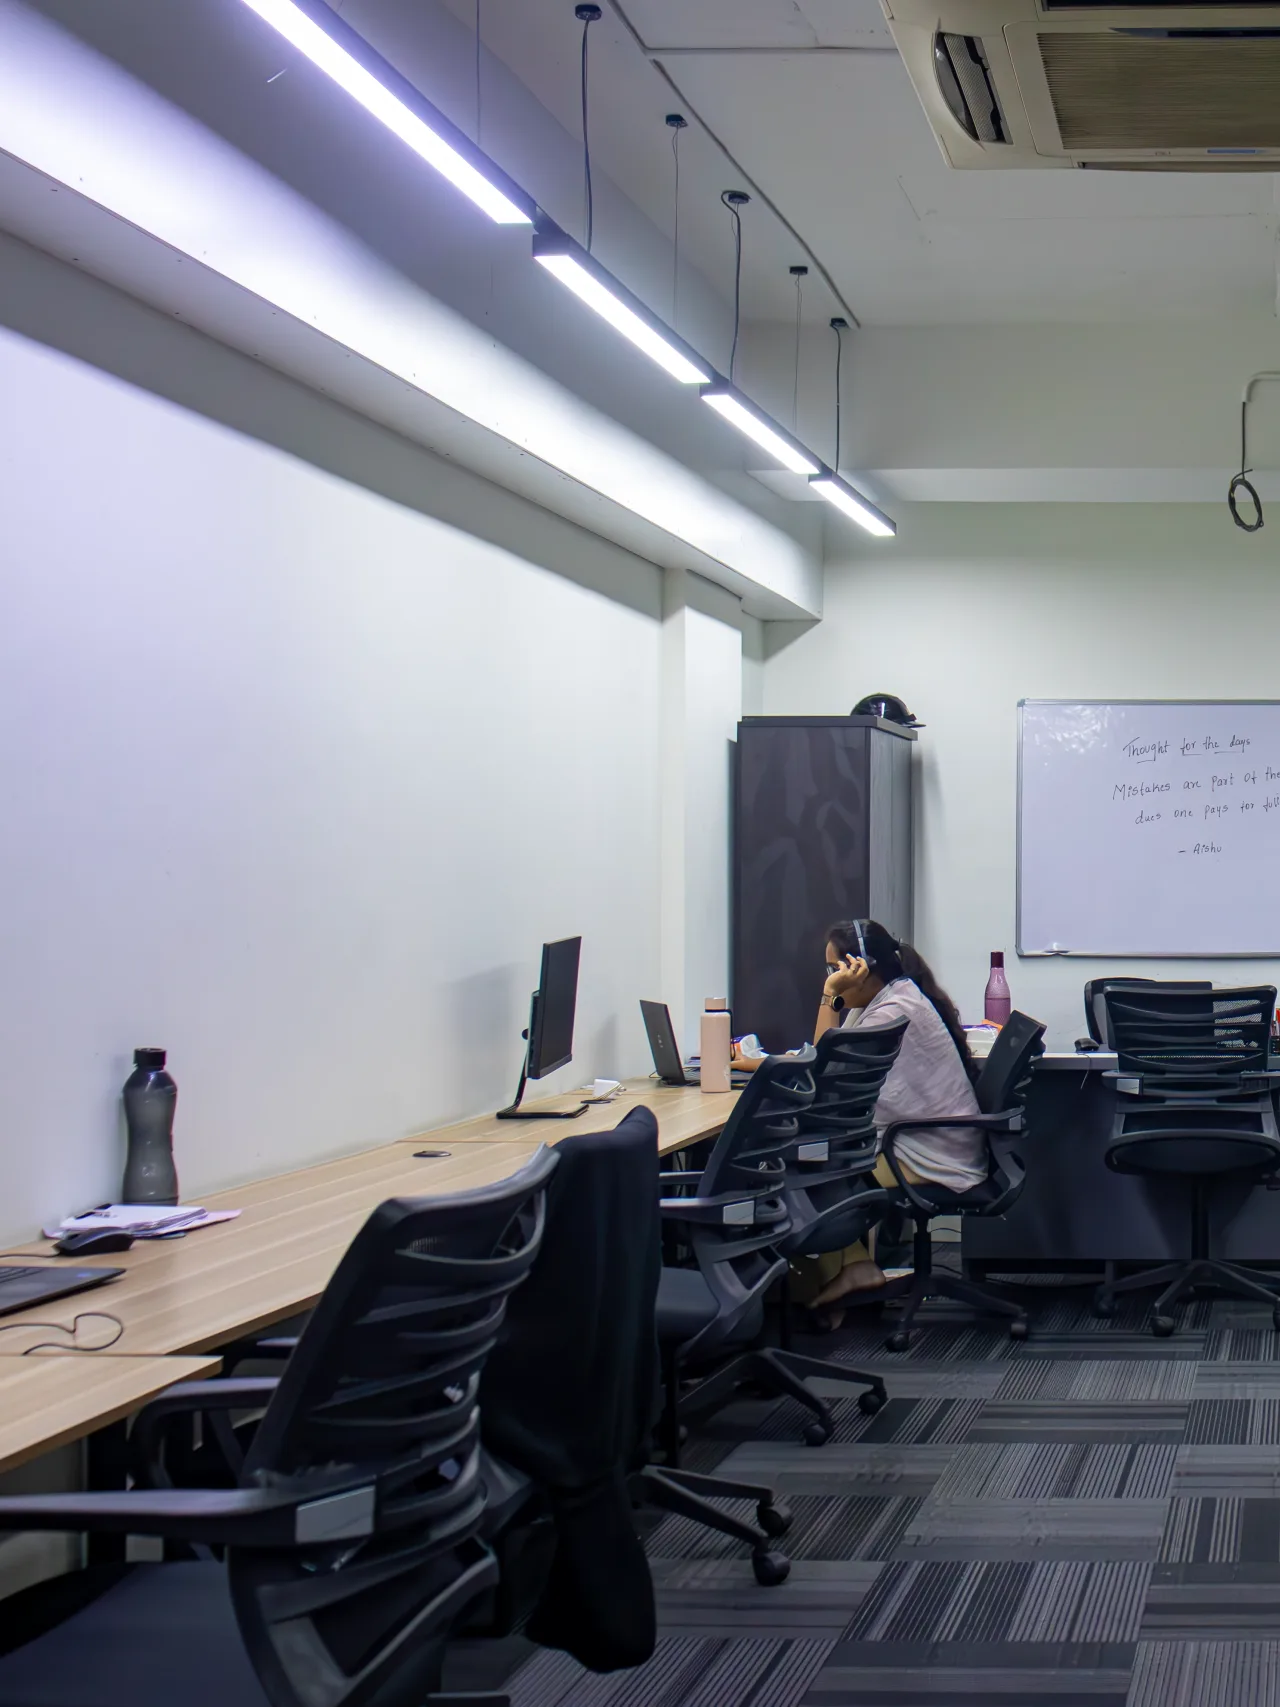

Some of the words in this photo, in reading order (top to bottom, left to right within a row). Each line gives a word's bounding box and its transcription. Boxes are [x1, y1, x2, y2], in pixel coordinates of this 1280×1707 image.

[1122, 736, 1170, 762] Thought
[1180, 737, 1197, 756] for
[1203, 736, 1219, 750] the
[1112, 783, 1171, 801] Mistakes
[1183, 780, 1202, 790] are
[1135, 810, 1162, 825] dues
[1173, 809, 1193, 818] one
[1240, 800, 1255, 814] for
